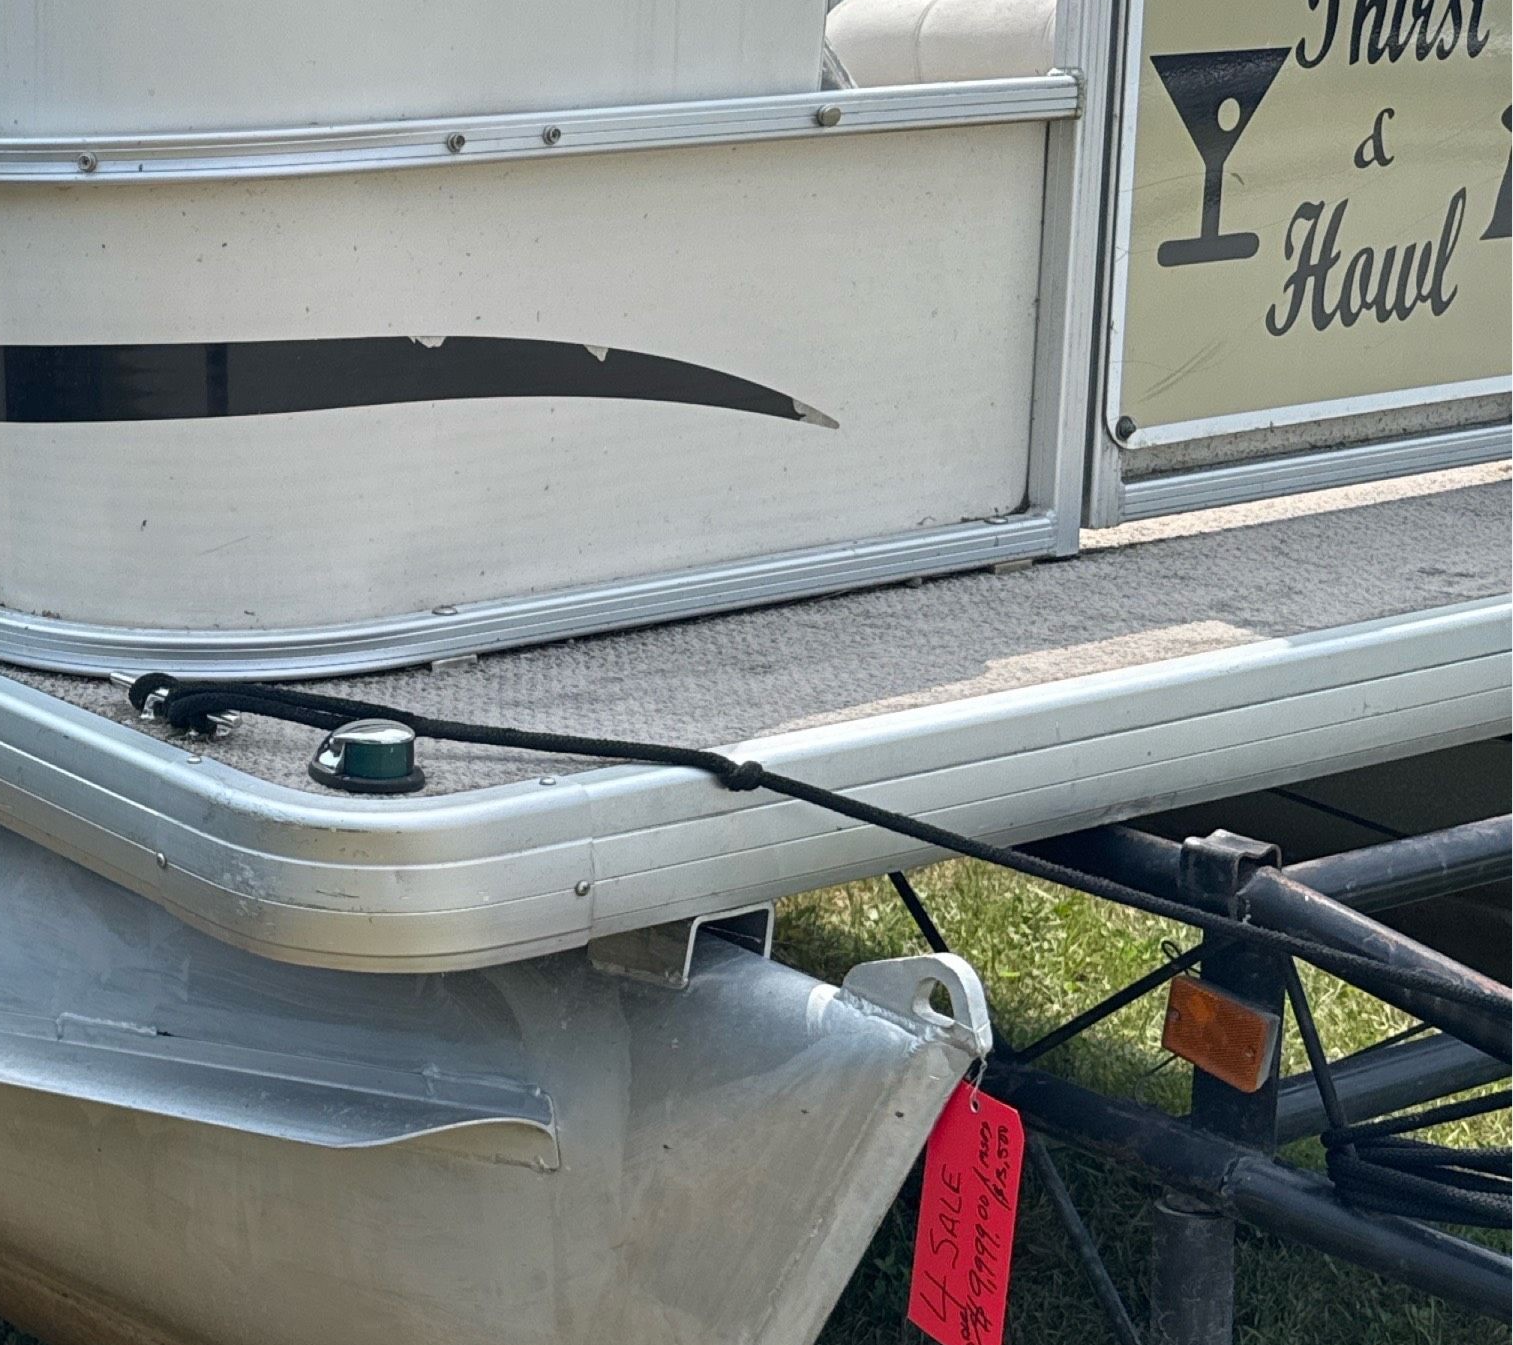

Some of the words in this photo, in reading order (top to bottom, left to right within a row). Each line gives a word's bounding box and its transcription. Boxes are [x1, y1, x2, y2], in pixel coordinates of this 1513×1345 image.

[1354, 107, 1394, 168] &
[1266, 187, 1466, 336] Howl
[929, 1164, 962, 1270] SALE
[919, 1270, 966, 1323] 4
